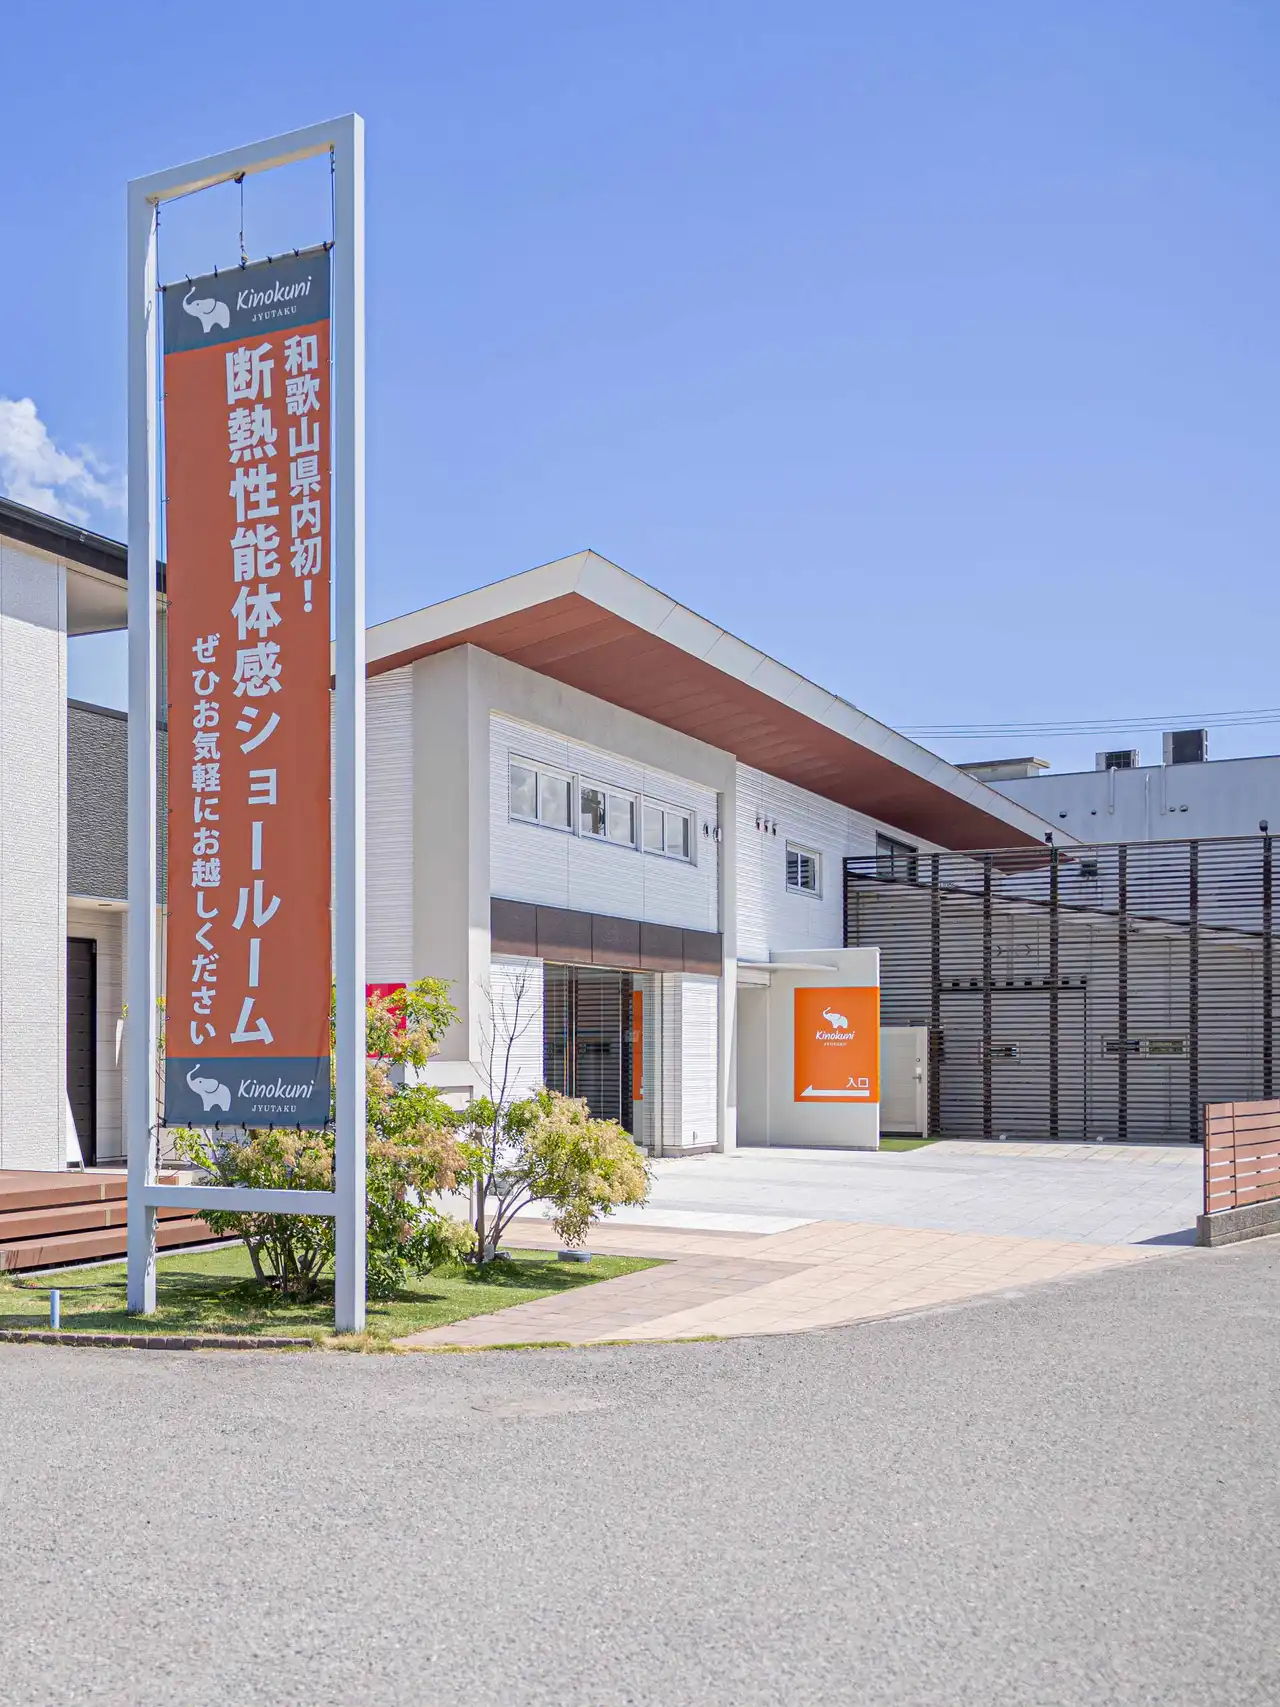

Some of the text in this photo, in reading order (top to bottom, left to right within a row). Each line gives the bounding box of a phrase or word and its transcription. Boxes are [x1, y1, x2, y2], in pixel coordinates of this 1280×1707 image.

[236, 276, 312, 311] Kinokuni
[252, 306, 297, 322] JYUTAKU
[283, 334, 322, 613] 和歌山県内初！
[225, 342, 282, 1046] 断熱性能体感ショールーム
[190, 632, 221, 1046] ぜひお気軽にお越しください
[237, 1077, 315, 1099] Kinokuni
[846, 1077, 869, 1088] 入口
[251, 1104, 297, 1113] JYUTAKU
